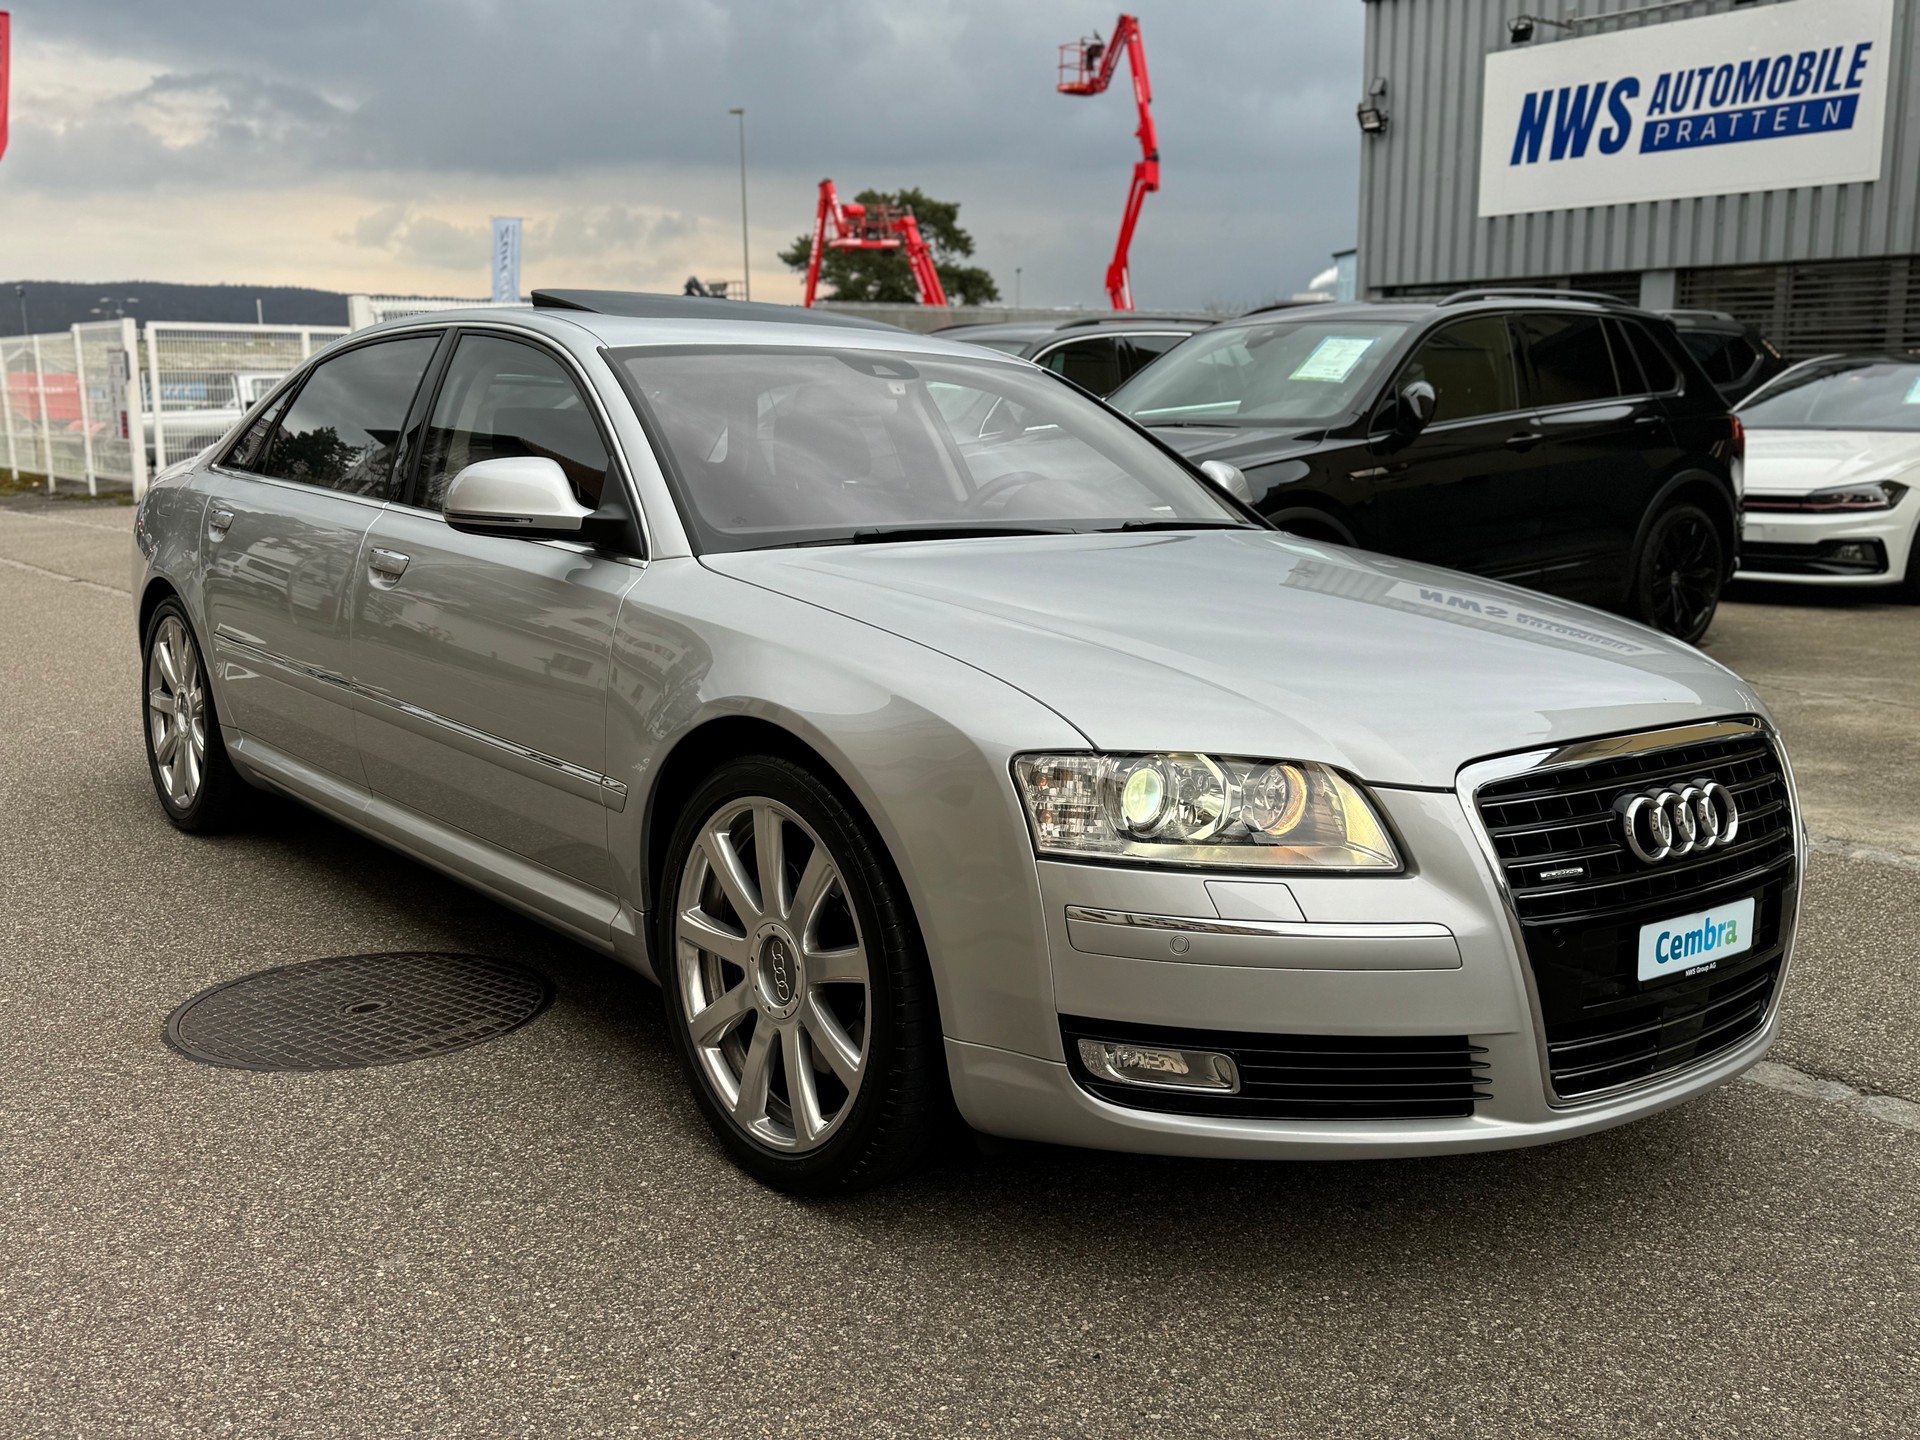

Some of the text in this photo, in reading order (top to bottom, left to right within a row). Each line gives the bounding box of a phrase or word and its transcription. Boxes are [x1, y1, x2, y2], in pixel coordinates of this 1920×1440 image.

[1510, 41, 1873, 166] NWS AUTOMOBILE
[1653, 99, 1843, 146] PRATTELN
[1655, 917, 1738, 965] Cembra
[1685, 961, 1717, 977] NWS Group AG
